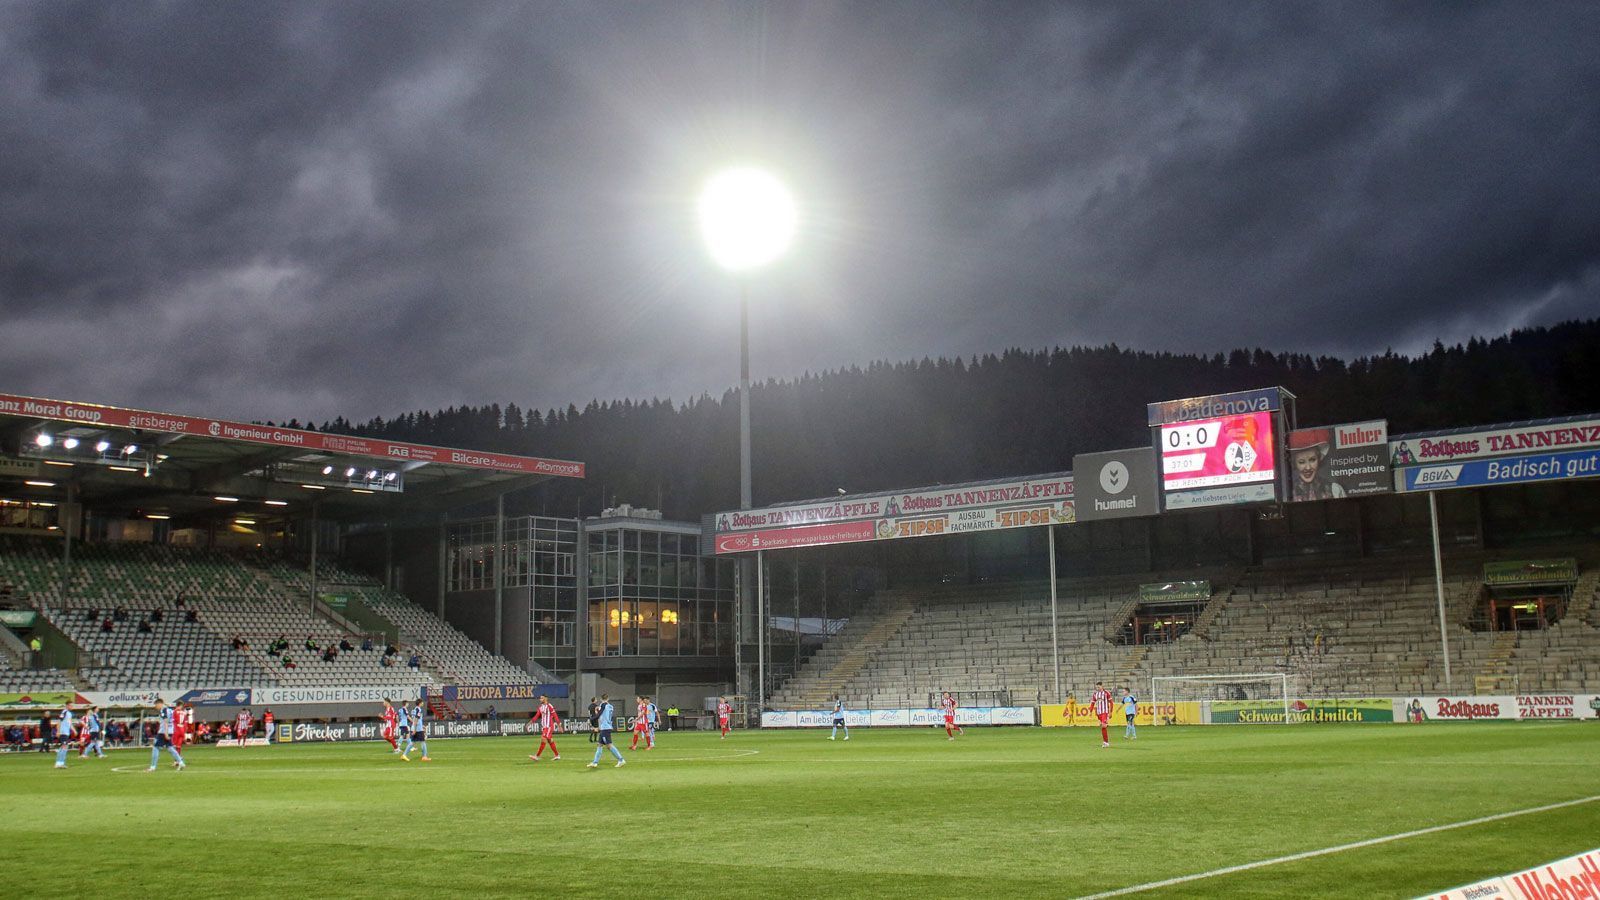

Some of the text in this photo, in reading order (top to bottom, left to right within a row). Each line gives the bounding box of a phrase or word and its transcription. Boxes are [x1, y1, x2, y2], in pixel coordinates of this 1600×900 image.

[23, 401, 61, 416] Morat
[64, 406, 102, 422] Group
[1178, 396, 1269, 420] badenova
[129, 414, 189, 432] girsberger
[224, 425, 272, 439] Ingenieur
[273, 431, 304, 444] GmbH
[1339, 427, 1382, 446] huber
[1418, 438, 1480, 459] Rothaus
[451, 452, 491, 466] Bilcare
[1330, 454, 1378, 467] Inspired by
[1330, 464, 1385, 477] temperature
[1487, 455, 1597, 480] Badisch gut
[902, 481, 1074, 511] Rothaus TANNENZÄPFLE
[1095, 495, 1137, 511] hummel
[732, 501, 880, 528] Rothaus TANNENZÄPFLE
[958, 511, 986, 521] AUSBAU
[1001, 509, 1050, 527] ZIPSE
[899, 519, 945, 536] ZIPSE
[761, 538, 788, 547] Sparkasse
[791, 531, 871, 544] www.sparkasse-freiburg.de
[272, 689, 405, 702] GESUNDHEITSRESORT
[457, 684, 536, 700] EUROPA PARK
[1436, 697, 1500, 719] Rothaus
[1516, 695, 1575, 706] TANNEN
[912, 713, 926, 722] Am
[1142, 704, 1176, 716] LOTTO
[1238, 707, 1363, 723] Schwarzwaldmilch
[1519, 706, 1575, 718] ZÄPFLE
[434, 722, 445, 735] im
[448, 719, 489, 735] Rieselfeld
[500, 720, 524, 734] immer
[813, 714, 833, 724] liebst
[295, 723, 345, 741] Strecker
[349, 723, 358, 737] in
[360, 722, 376, 737] der
